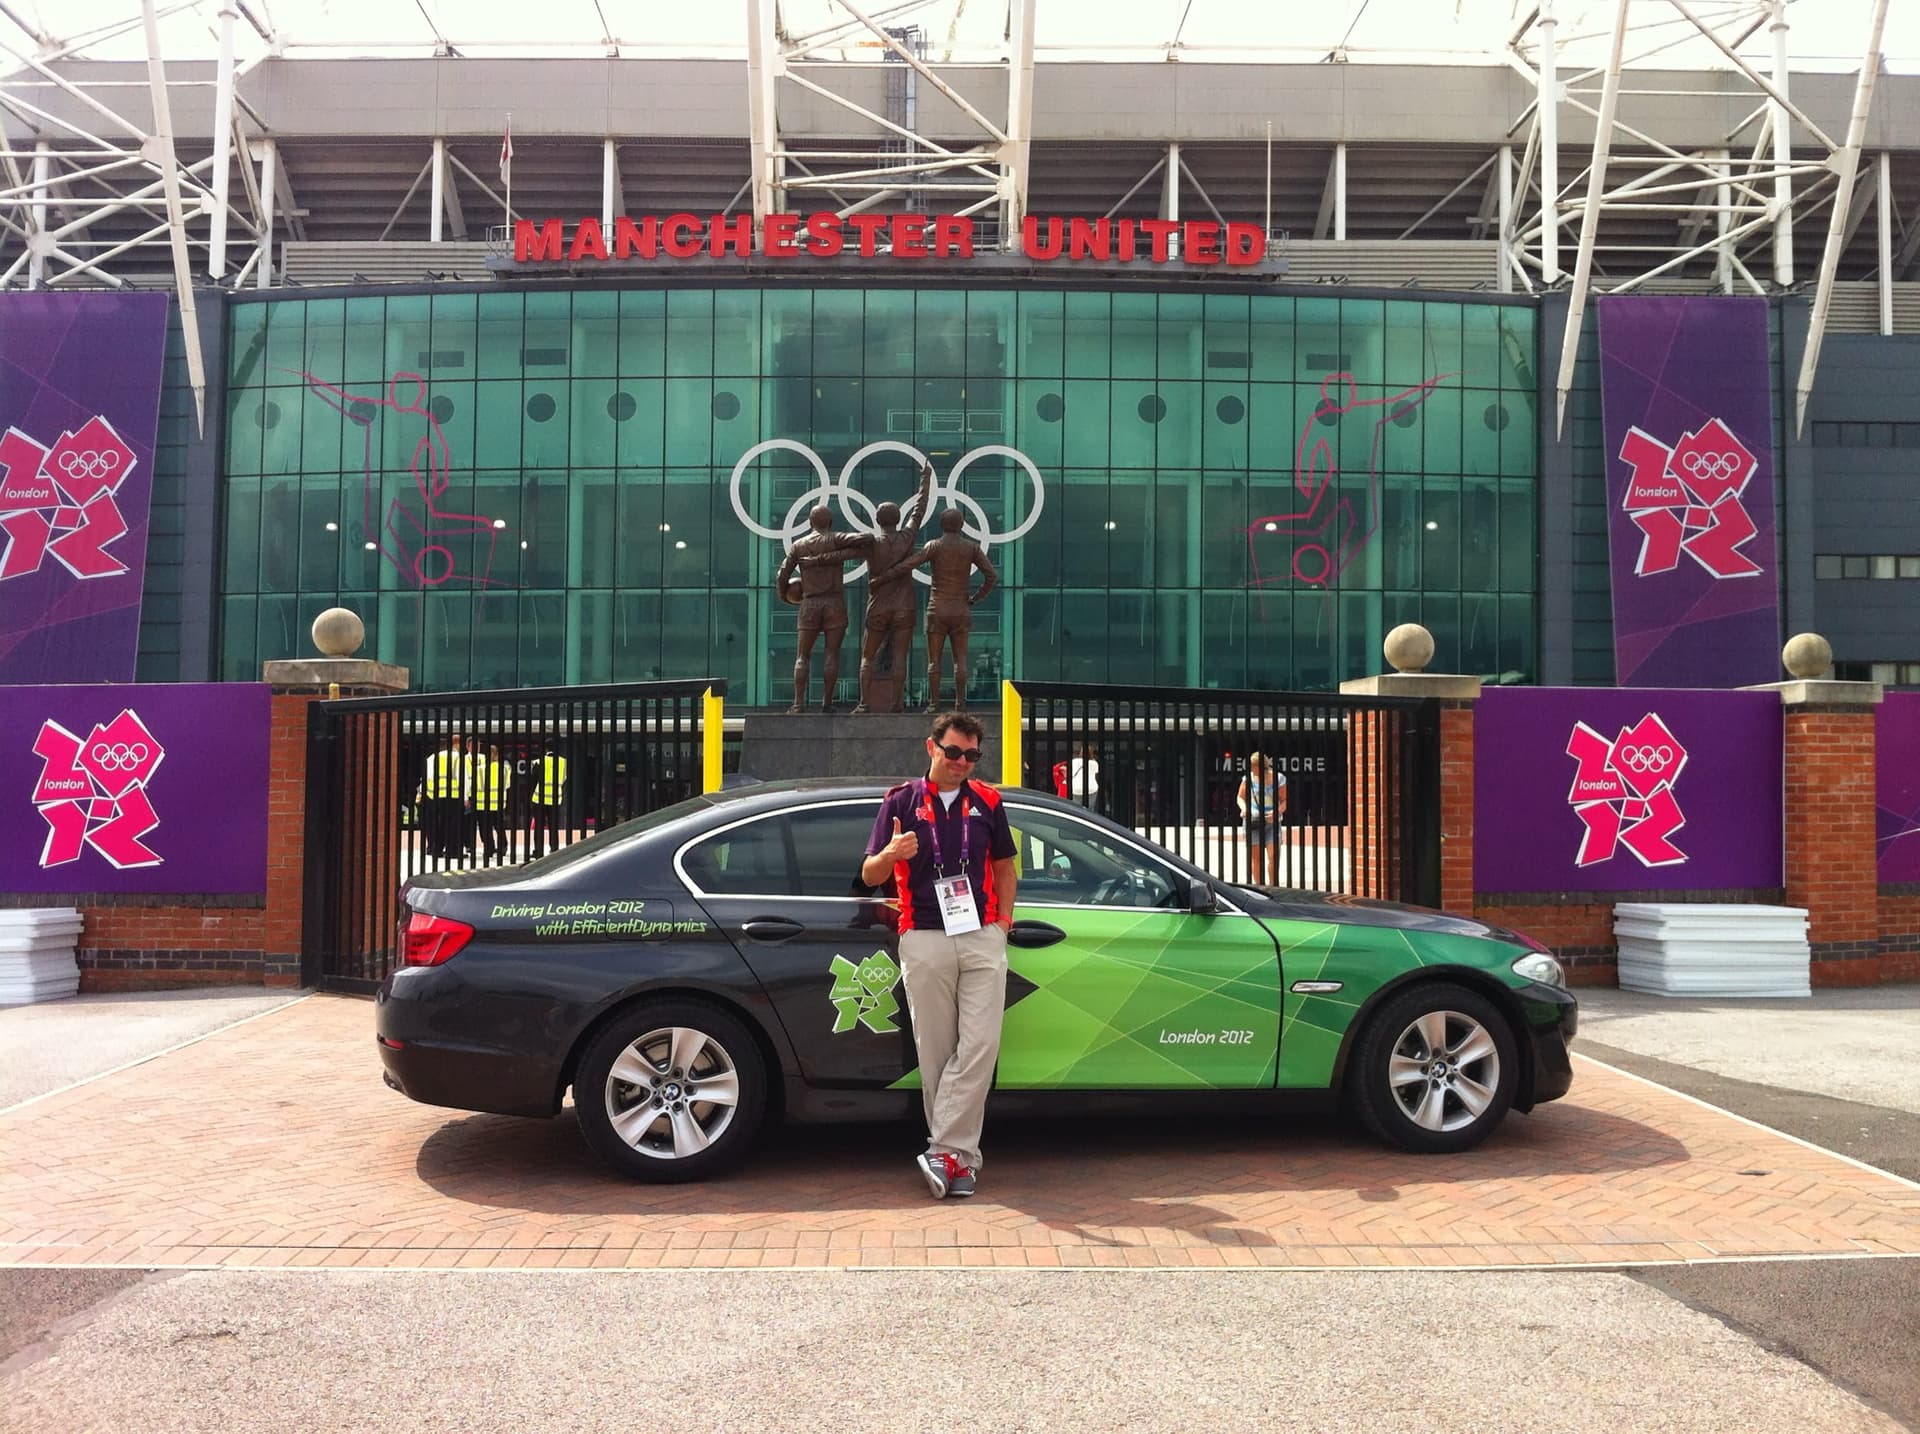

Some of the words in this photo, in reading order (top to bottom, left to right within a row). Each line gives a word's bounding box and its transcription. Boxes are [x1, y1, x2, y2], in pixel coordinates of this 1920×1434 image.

[513, 211, 976, 262] MANCHESTER
[1023, 216, 1267, 265] UNITED
[5, 487, 49, 499] london
[1635, 486, 1678, 497] london
[44, 778, 85, 790] london
[1579, 779, 1617, 791] london
[491, 903, 543, 920] Driving
[546, 901, 606, 916] London
[608, 901, 645, 914] 2012
[535, 920, 569, 936] with
[571, 917, 709, 937] EfficientDynamics
[1159, 1028, 1216, 1044] London
[1219, 1030, 1254, 1044] 2012
